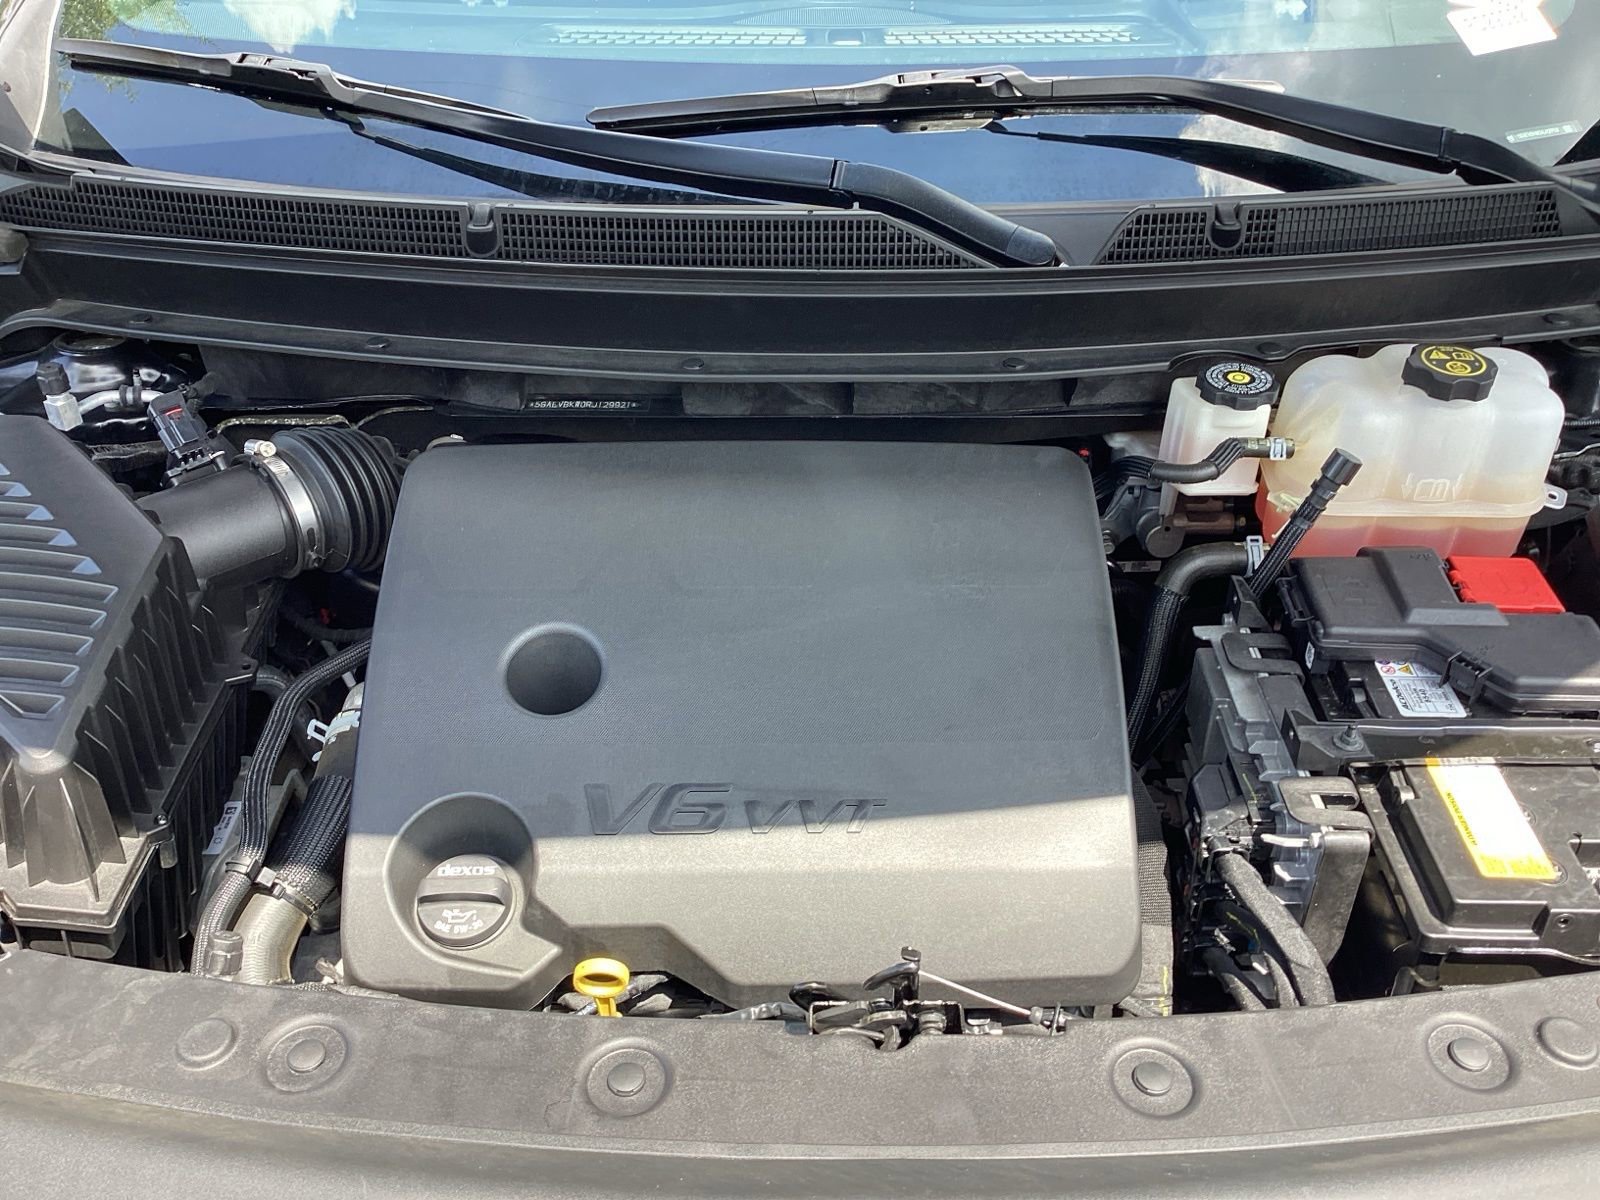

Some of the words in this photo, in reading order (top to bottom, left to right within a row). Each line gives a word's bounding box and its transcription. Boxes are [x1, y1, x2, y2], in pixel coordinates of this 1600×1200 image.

[583, 782, 735, 836] V6
[743, 798, 888, 834] VVT
[437, 863, 499, 877] dexos
